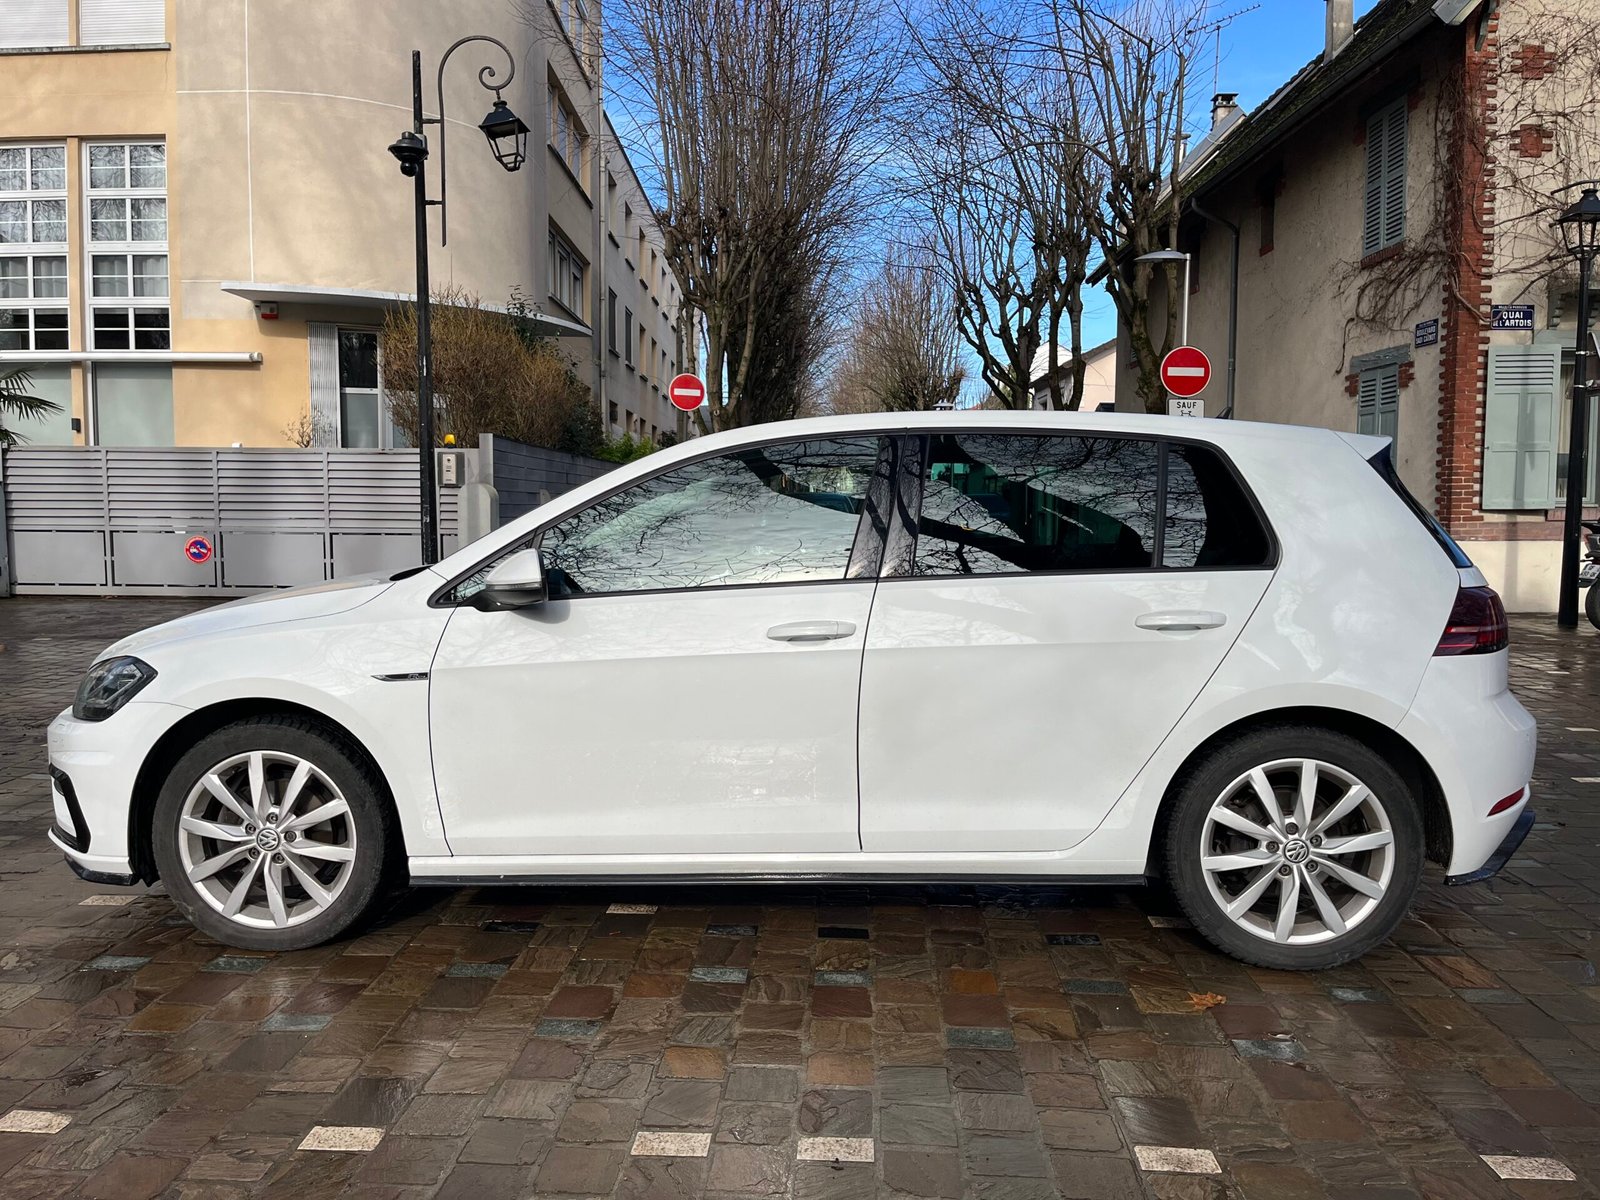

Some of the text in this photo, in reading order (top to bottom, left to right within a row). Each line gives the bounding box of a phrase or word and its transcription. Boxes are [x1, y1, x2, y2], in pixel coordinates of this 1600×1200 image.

[1502, 311, 1523, 320] QUAI
[1499, 319, 1532, 327] L'ARTOIS
[1176, 401, 1197, 409] SAUF
